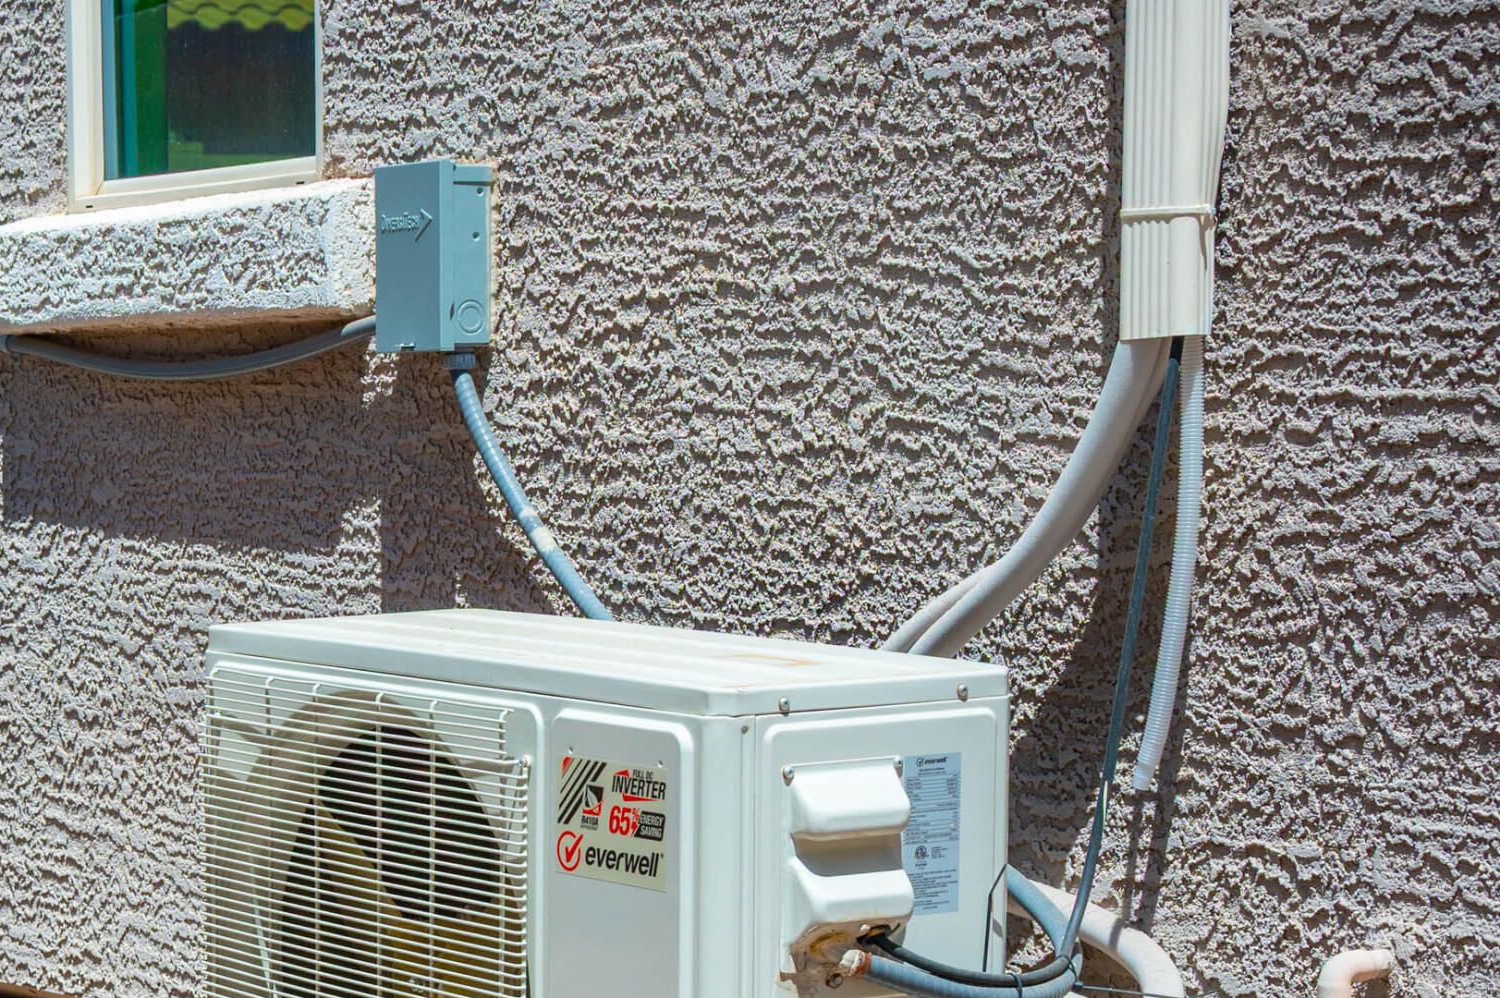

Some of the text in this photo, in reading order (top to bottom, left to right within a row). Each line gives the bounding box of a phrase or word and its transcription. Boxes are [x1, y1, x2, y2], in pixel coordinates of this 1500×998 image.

[611, 774, 667, 800] INVERTER
[632, 769, 654, 780] FULL DC
[585, 846, 659, 877] everwell
